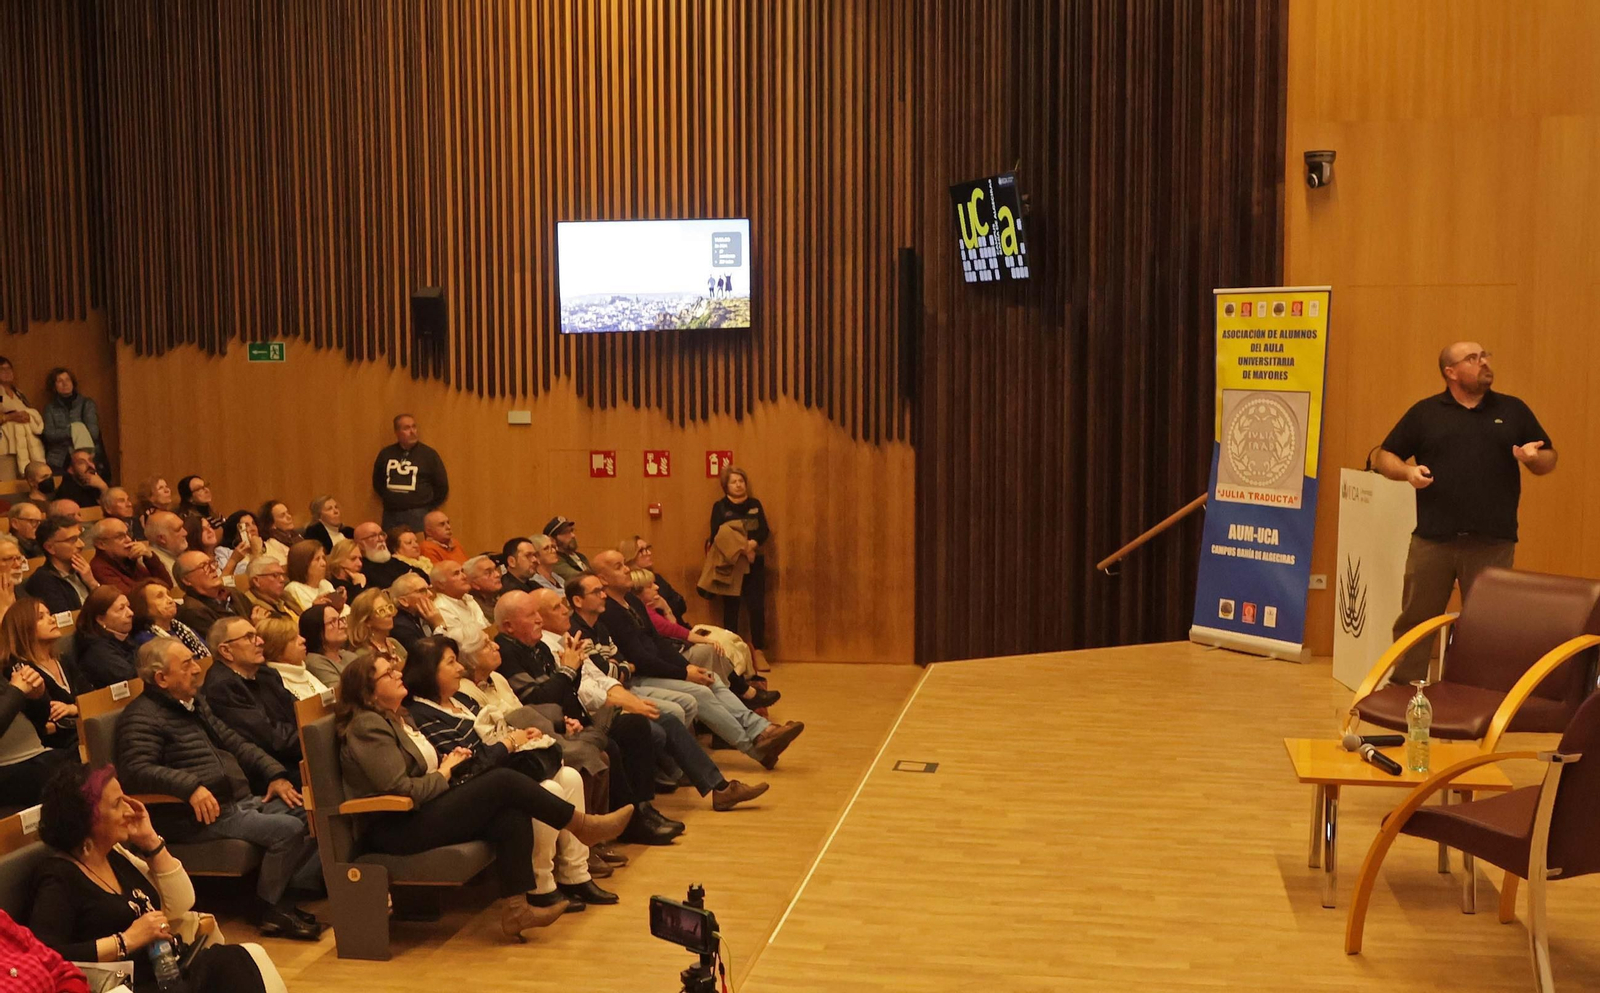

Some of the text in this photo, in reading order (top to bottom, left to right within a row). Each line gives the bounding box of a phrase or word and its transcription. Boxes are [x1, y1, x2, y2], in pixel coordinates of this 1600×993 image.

[1222, 329, 1317, 339] ASOCIACIÓN DE ALUMNOS
[1250, 343, 1284, 353] DEL AULA
[1238, 357, 1295, 366] UNIVERSITARIA
[1242, 370, 1288, 380] DE MAYORES
[1217, 489, 1299, 504] "JULIA TRADUCTA"
[1228, 524, 1279, 546] AUM-UCA
[1211, 544, 1236, 556] CAMPUS
[1254, 549, 1262, 560] DE
[1262, 550, 1296, 565] ALGECIRAS
